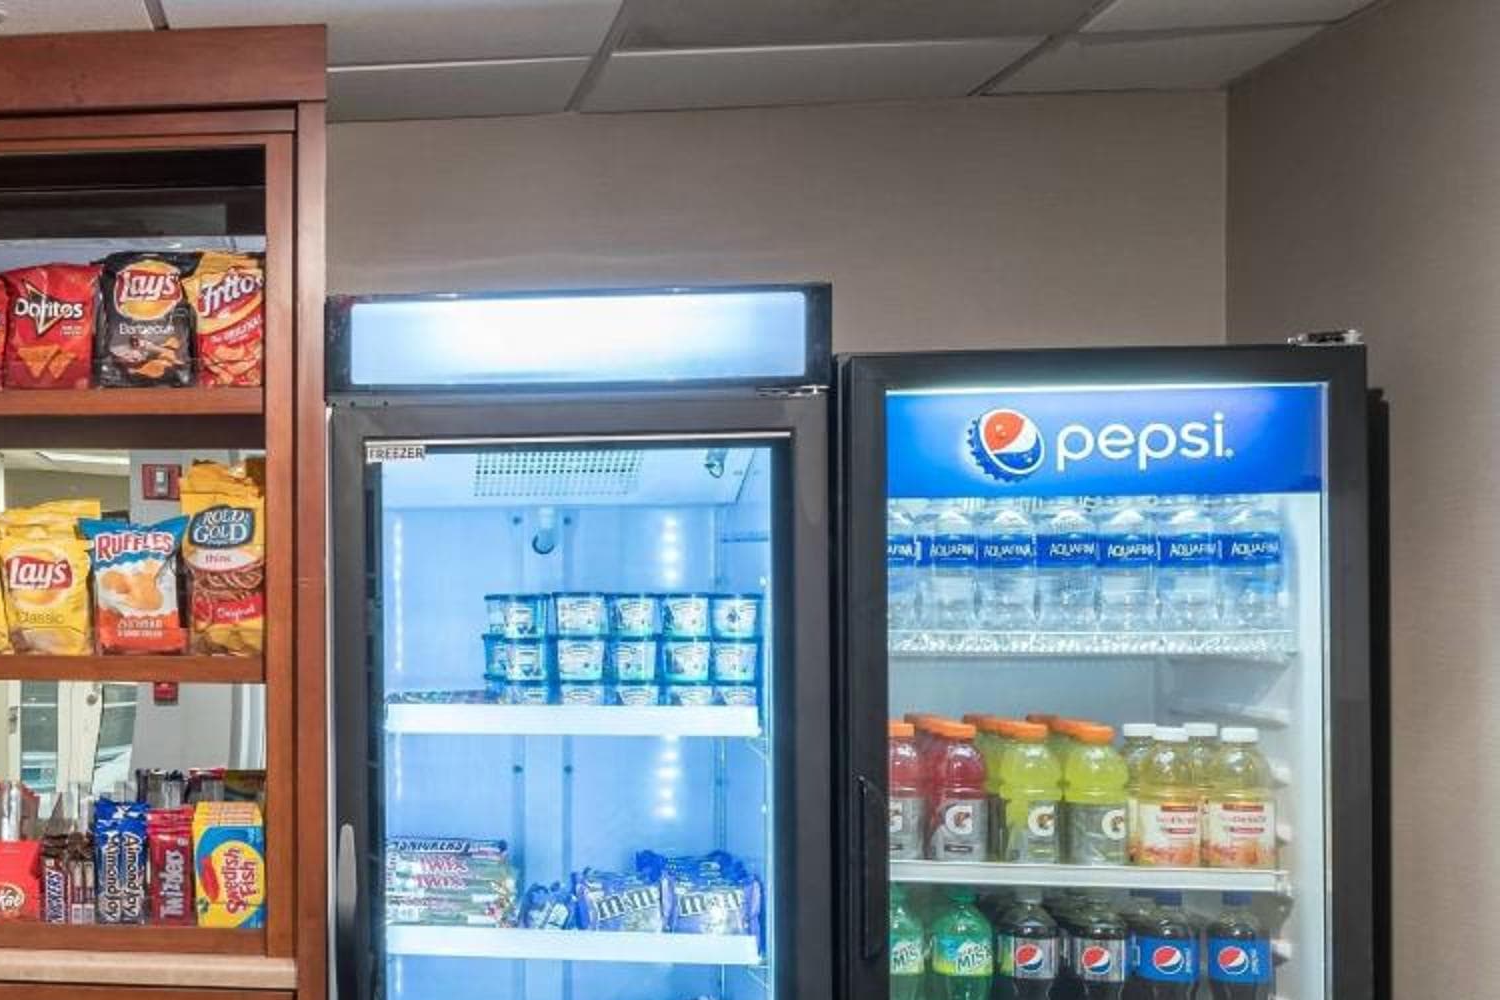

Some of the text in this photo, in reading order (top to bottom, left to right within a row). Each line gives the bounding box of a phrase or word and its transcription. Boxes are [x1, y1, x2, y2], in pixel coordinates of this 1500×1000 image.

[14, 298, 84, 319] Doritos
[1056, 411, 1225, 472] pepsi
[203, 509, 246, 524] ROLD
[95, 530, 175, 561] RUFFLES
[193, 523, 247, 543] GOLD
[9, 556, 68, 589] Lay's
[122, 831, 143, 889] Almond
[223, 847, 258, 915] Swedish Fish
